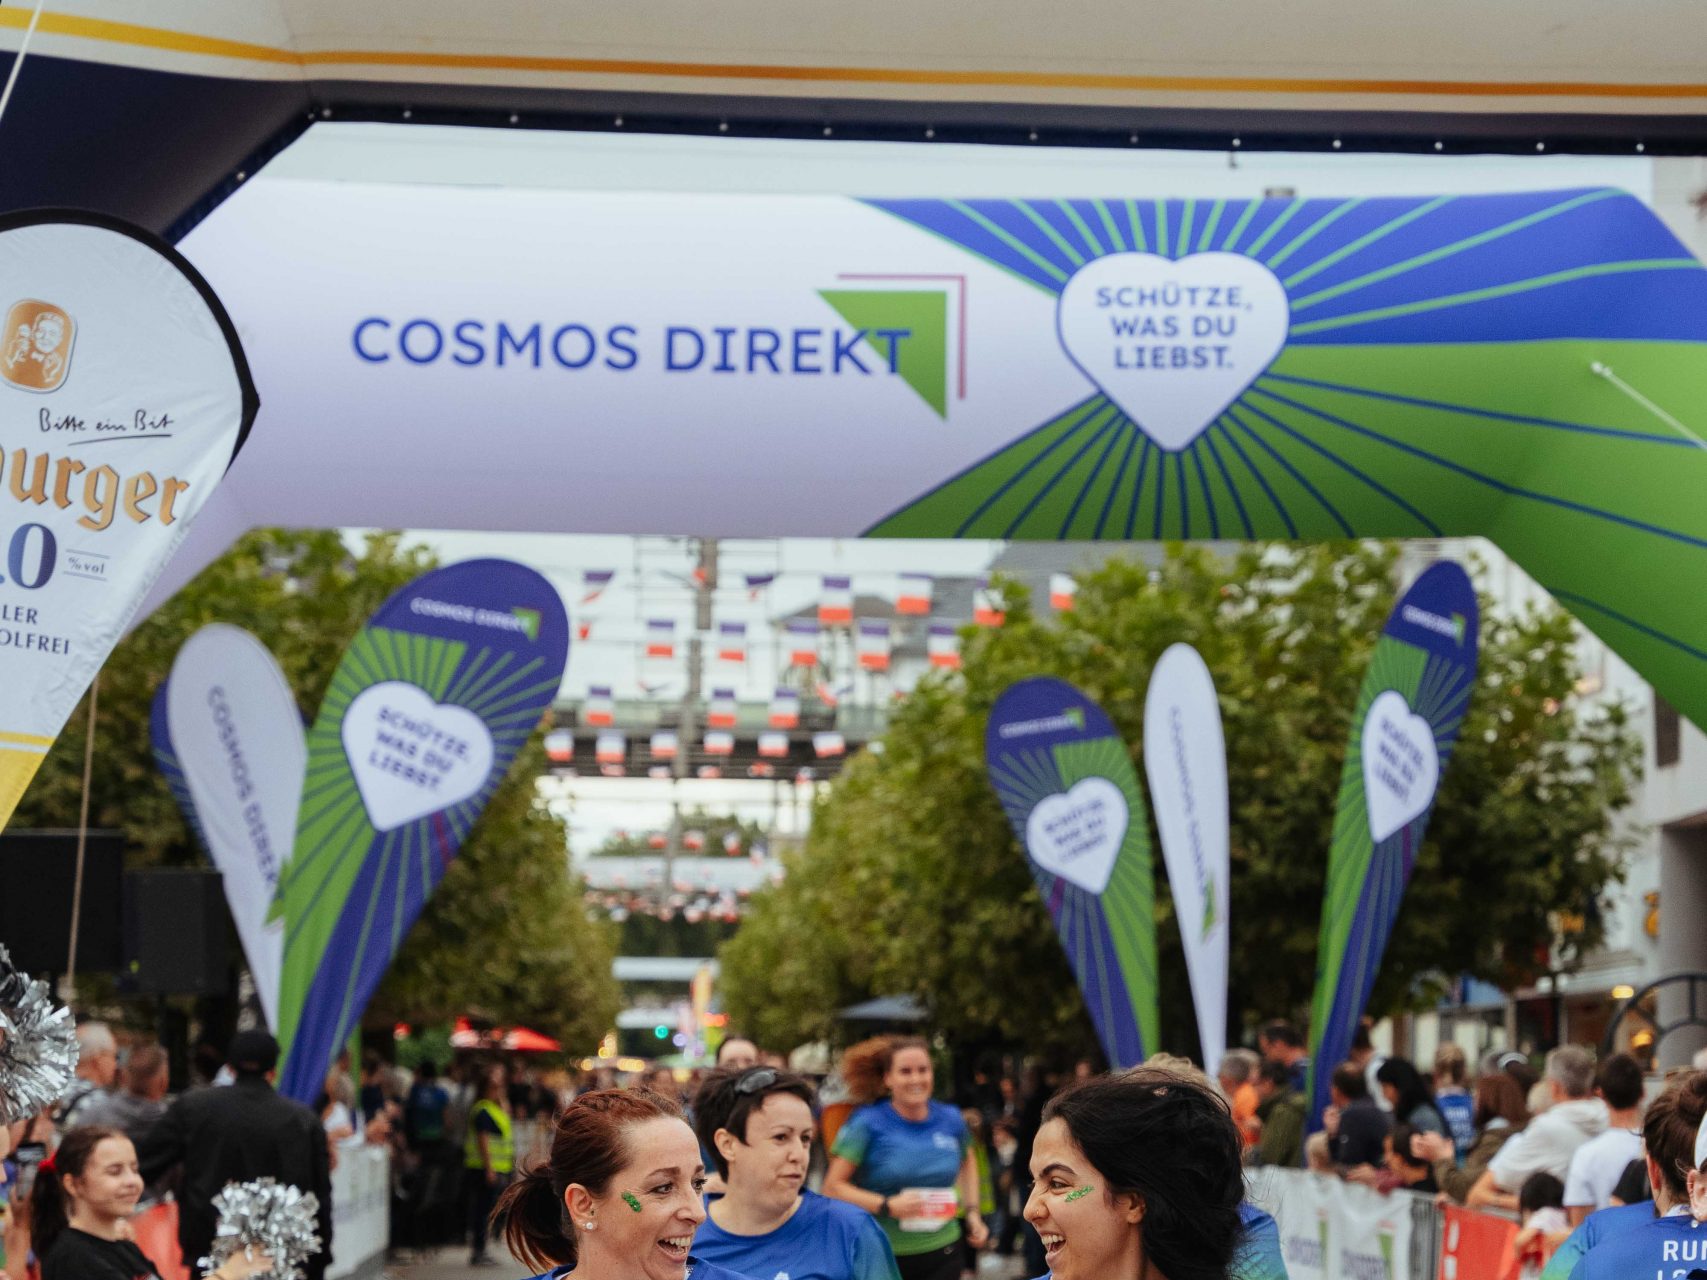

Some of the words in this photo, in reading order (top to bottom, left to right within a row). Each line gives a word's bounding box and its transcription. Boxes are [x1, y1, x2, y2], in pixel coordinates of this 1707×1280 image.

[1095, 281, 1252, 310] SCHÜTZE,
[1110, 315, 1180, 337] WAS
[1192, 315, 1237, 337] DU
[352, 317, 639, 371] COSMOS
[665, 326, 912, 376] DIREKT
[1114, 346, 1234, 369] LIEBST.
[39, 408, 86, 432] Bitte
[96, 420, 127, 432] ein
[134, 409, 174, 432] Bit
[0, 447, 190, 532] urger
[207, 685, 255, 800] COSMOS
[376, 729, 418, 760] WAS
[422, 749, 454, 774] DU
